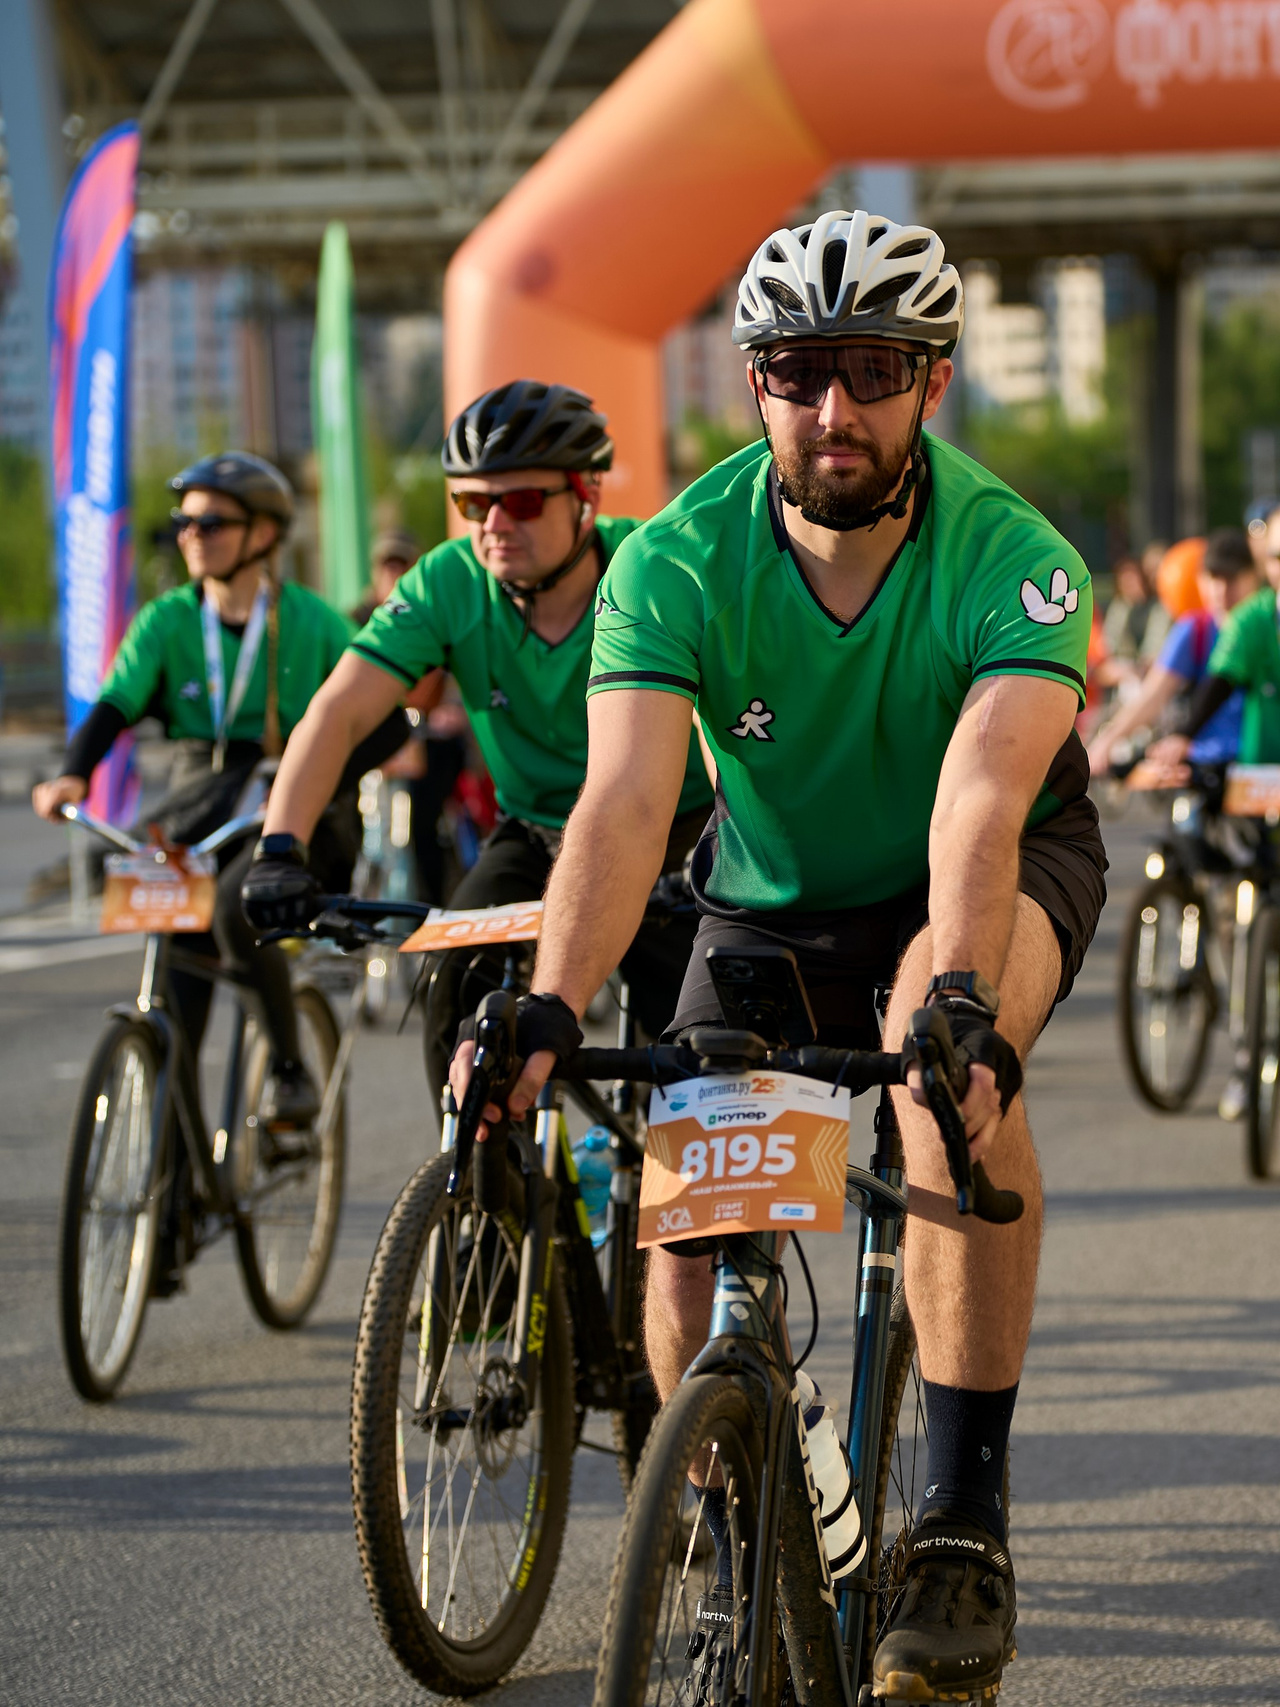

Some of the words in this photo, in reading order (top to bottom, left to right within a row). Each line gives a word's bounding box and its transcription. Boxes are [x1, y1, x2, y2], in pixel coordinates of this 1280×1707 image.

[698, 1081, 750, 1102] фонтанка.ру
[751, 1078, 776, 1094] 25
[718, 1111, 767, 1123] купер
[679, 1133, 796, 1183] 8195
[715, 1201, 744, 1212] СТАРТ
[913, 1536, 986, 1552] northwave
[701, 1611, 734, 1622] northw
